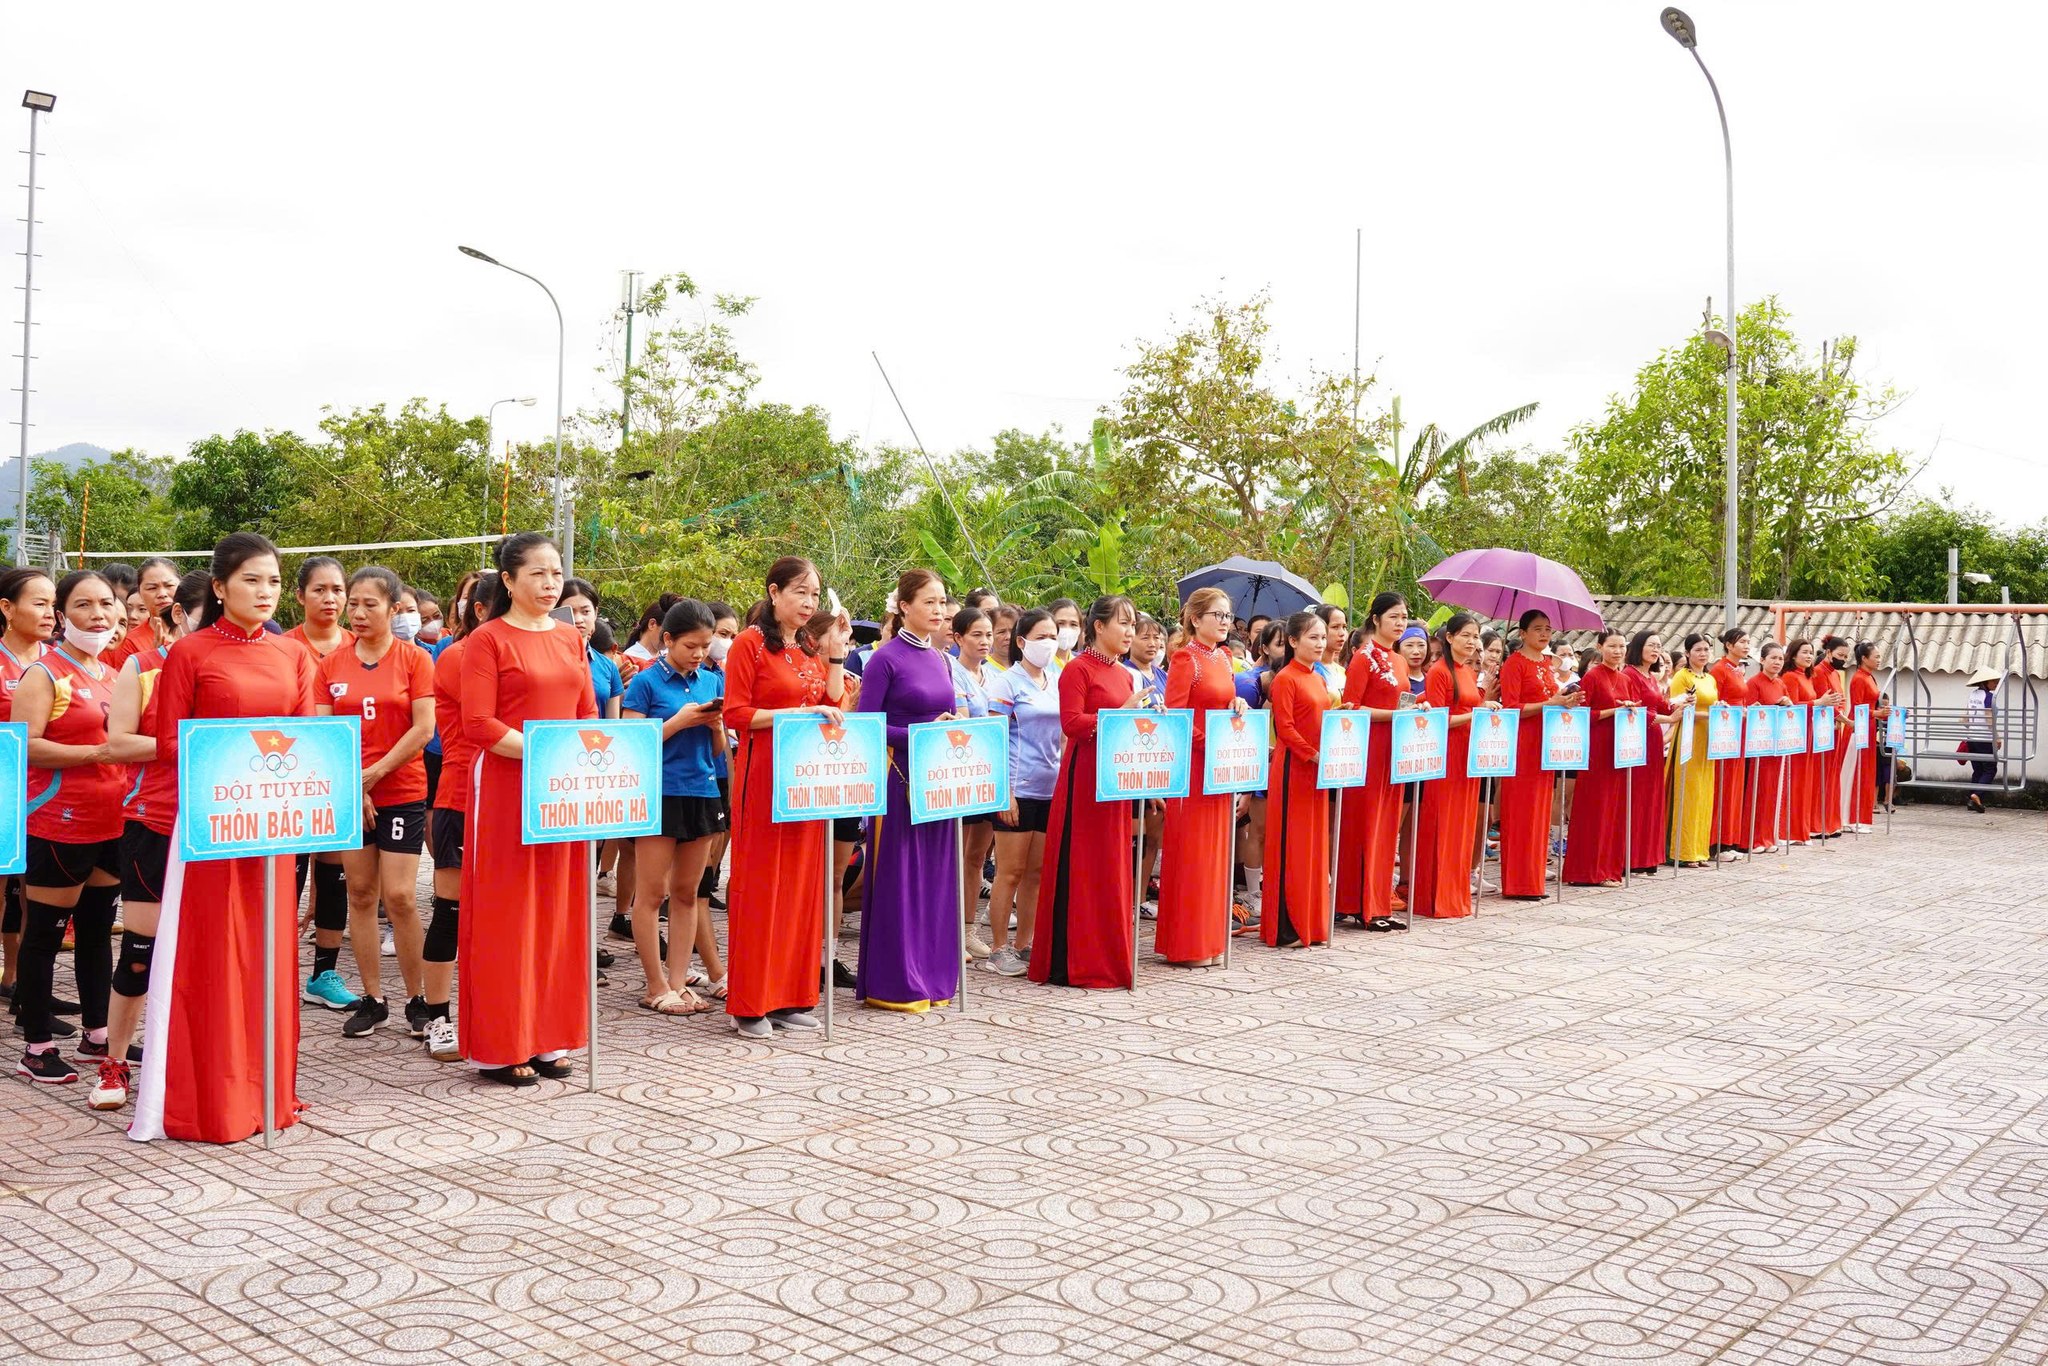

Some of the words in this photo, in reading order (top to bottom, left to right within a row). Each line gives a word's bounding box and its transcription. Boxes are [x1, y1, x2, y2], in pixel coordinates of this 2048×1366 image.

[362, 696, 376, 720] 6
[795, 761, 819, 780] ĐỘI
[824, 754, 868, 776] TUYỂN
[1114, 750, 1133, 766] ĐỘI
[1138, 744, 1174, 763] TUYỂN
[549, 773, 579, 795] ĐỘI
[584, 766, 640, 790] TUYỂN
[928, 766, 948, 783] ĐỘI
[952, 757, 992, 778] TUYỂN
[1118, 767, 1143, 789] THÔN
[214, 780, 253, 804] ĐỘI
[259, 771, 331, 799] TUYỂN
[787, 783, 811, 809] THÔN
[814, 785, 840, 807] TRUNG
[843, 782, 875, 809] THƯỢNG
[925, 785, 952, 809] THÔN
[975, 780, 995, 803] YÊN
[209, 808, 259, 843] THÔN
[267, 801, 304, 839] BẮC
[311, 803, 336, 835] HÀ
[540, 797, 579, 828] THÔN
[630, 793, 648, 822] HÀ
[392, 817, 405, 841] 6
